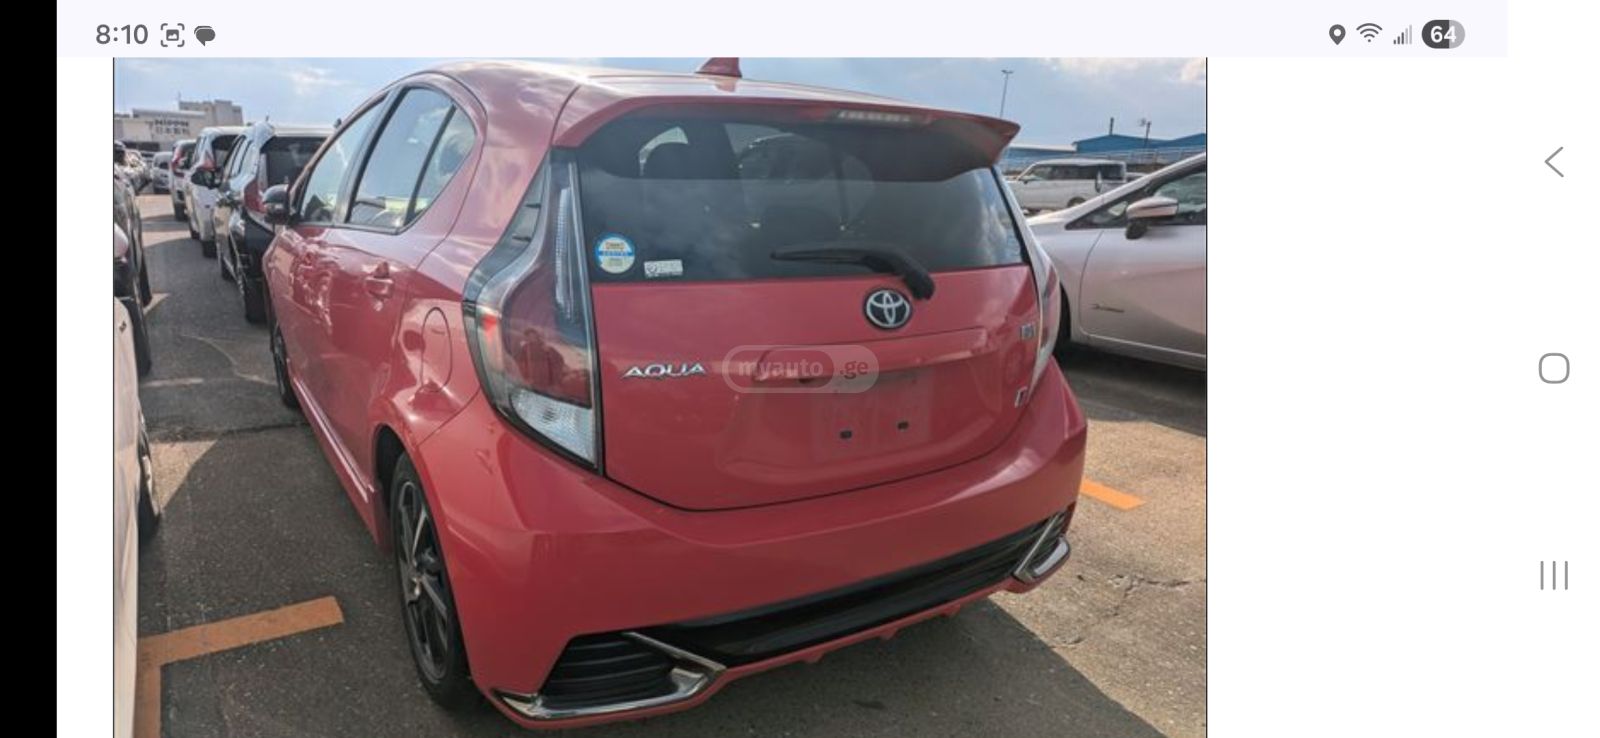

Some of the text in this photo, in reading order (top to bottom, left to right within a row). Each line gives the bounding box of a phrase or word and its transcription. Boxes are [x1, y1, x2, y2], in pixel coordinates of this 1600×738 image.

[96, 24, 149, 44] 8:10
[1430, 25, 1457, 43] 64
[622, 362, 707, 380] AQUA
